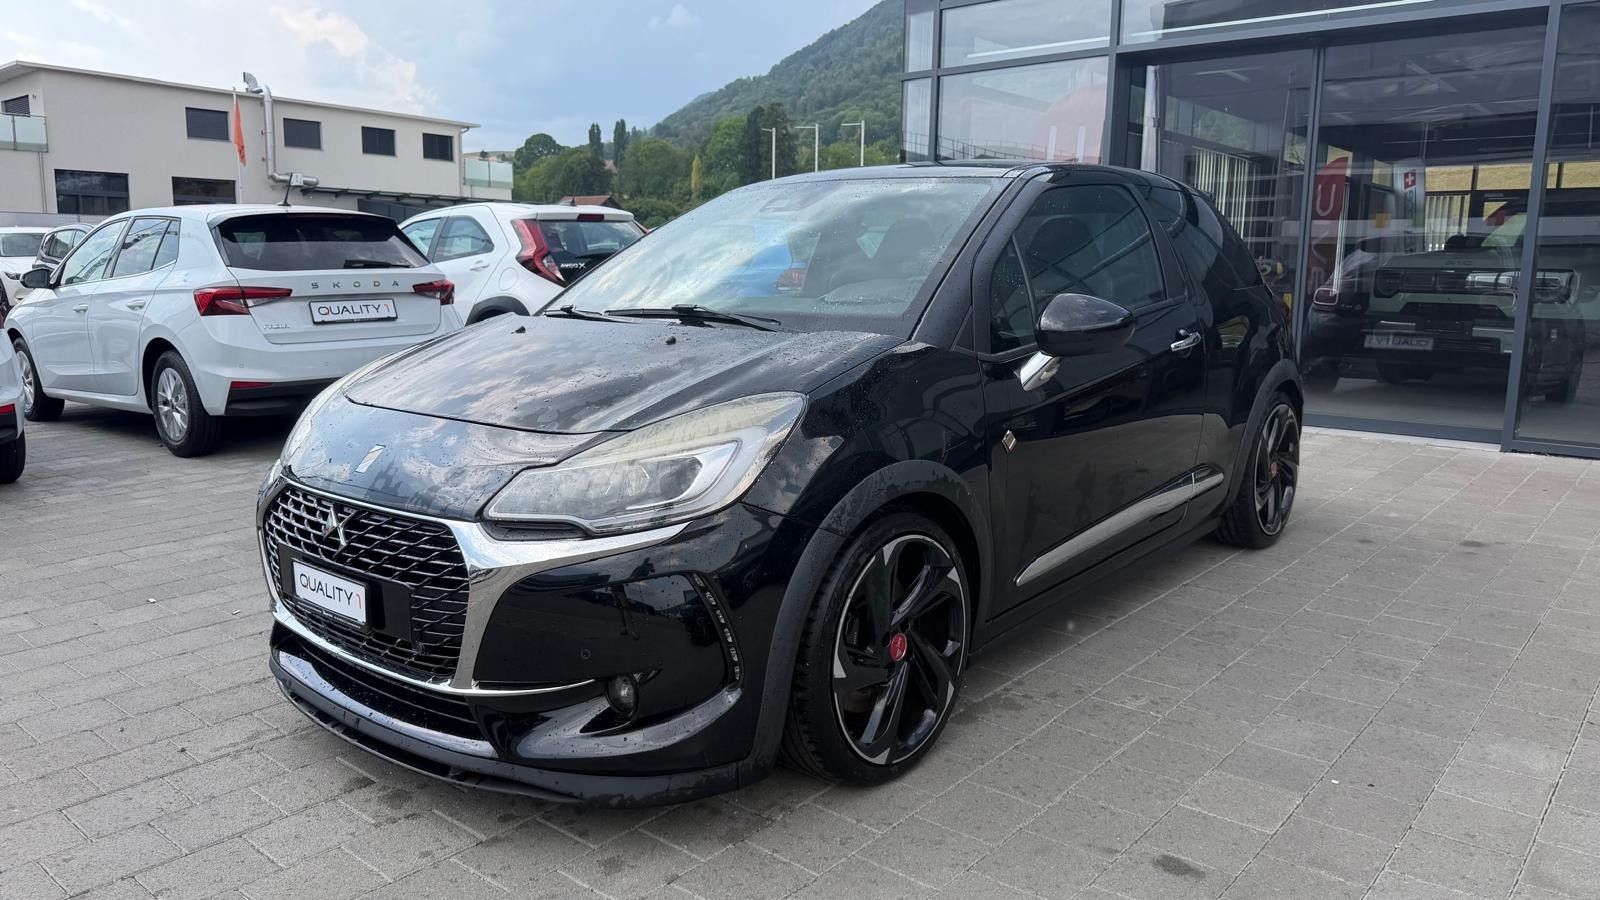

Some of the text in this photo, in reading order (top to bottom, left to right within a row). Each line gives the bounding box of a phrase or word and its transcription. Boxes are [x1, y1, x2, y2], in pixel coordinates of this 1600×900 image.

[318, 304, 390, 316] QUALITY 1
[300, 573, 362, 609] QUALITY 1
